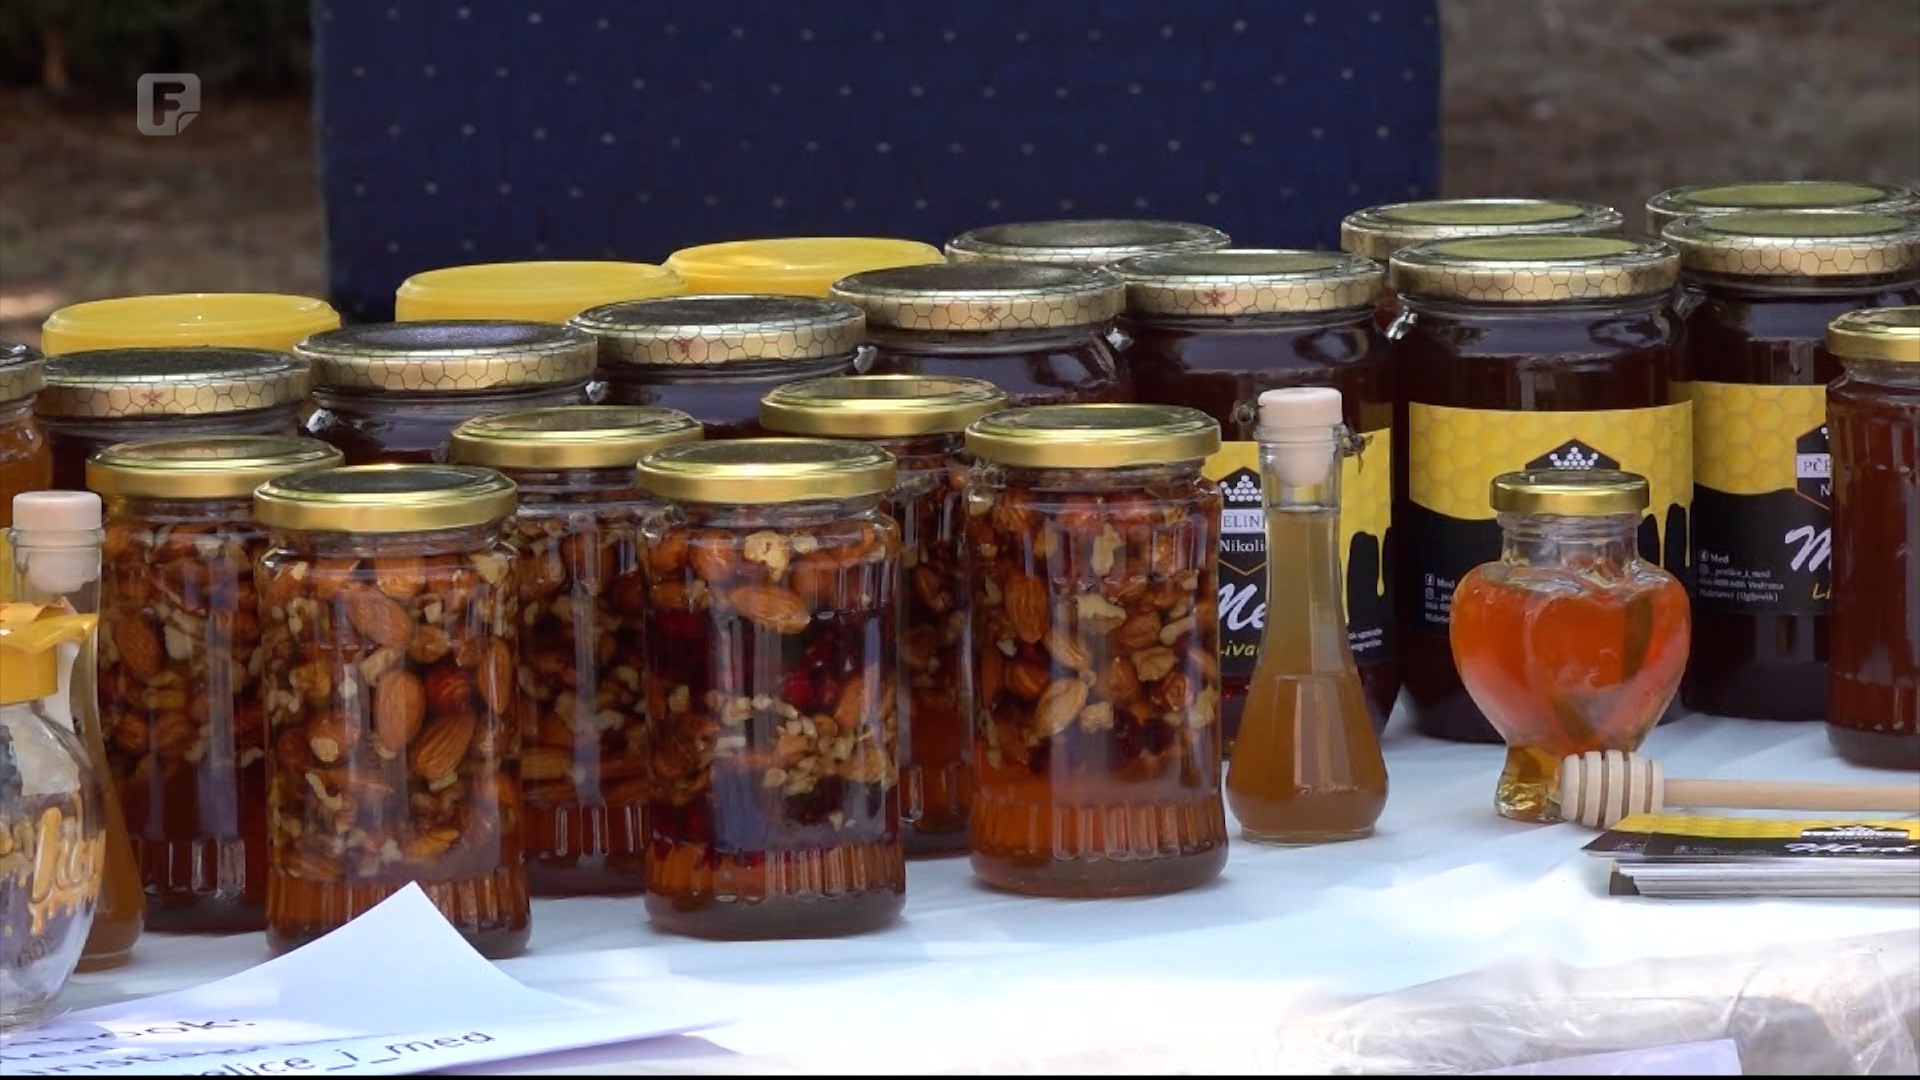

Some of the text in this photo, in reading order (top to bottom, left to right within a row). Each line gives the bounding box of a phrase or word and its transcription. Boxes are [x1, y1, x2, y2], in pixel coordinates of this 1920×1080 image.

[1820, 483, 1831, 497] N
[1222, 514, 1266, 529] ELIN
[1218, 539, 1266, 552] Nikoli
[1784, 525, 1832, 572] M
[1812, 582, 1832, 600] Li
[1218, 582, 1266, 631] Me
